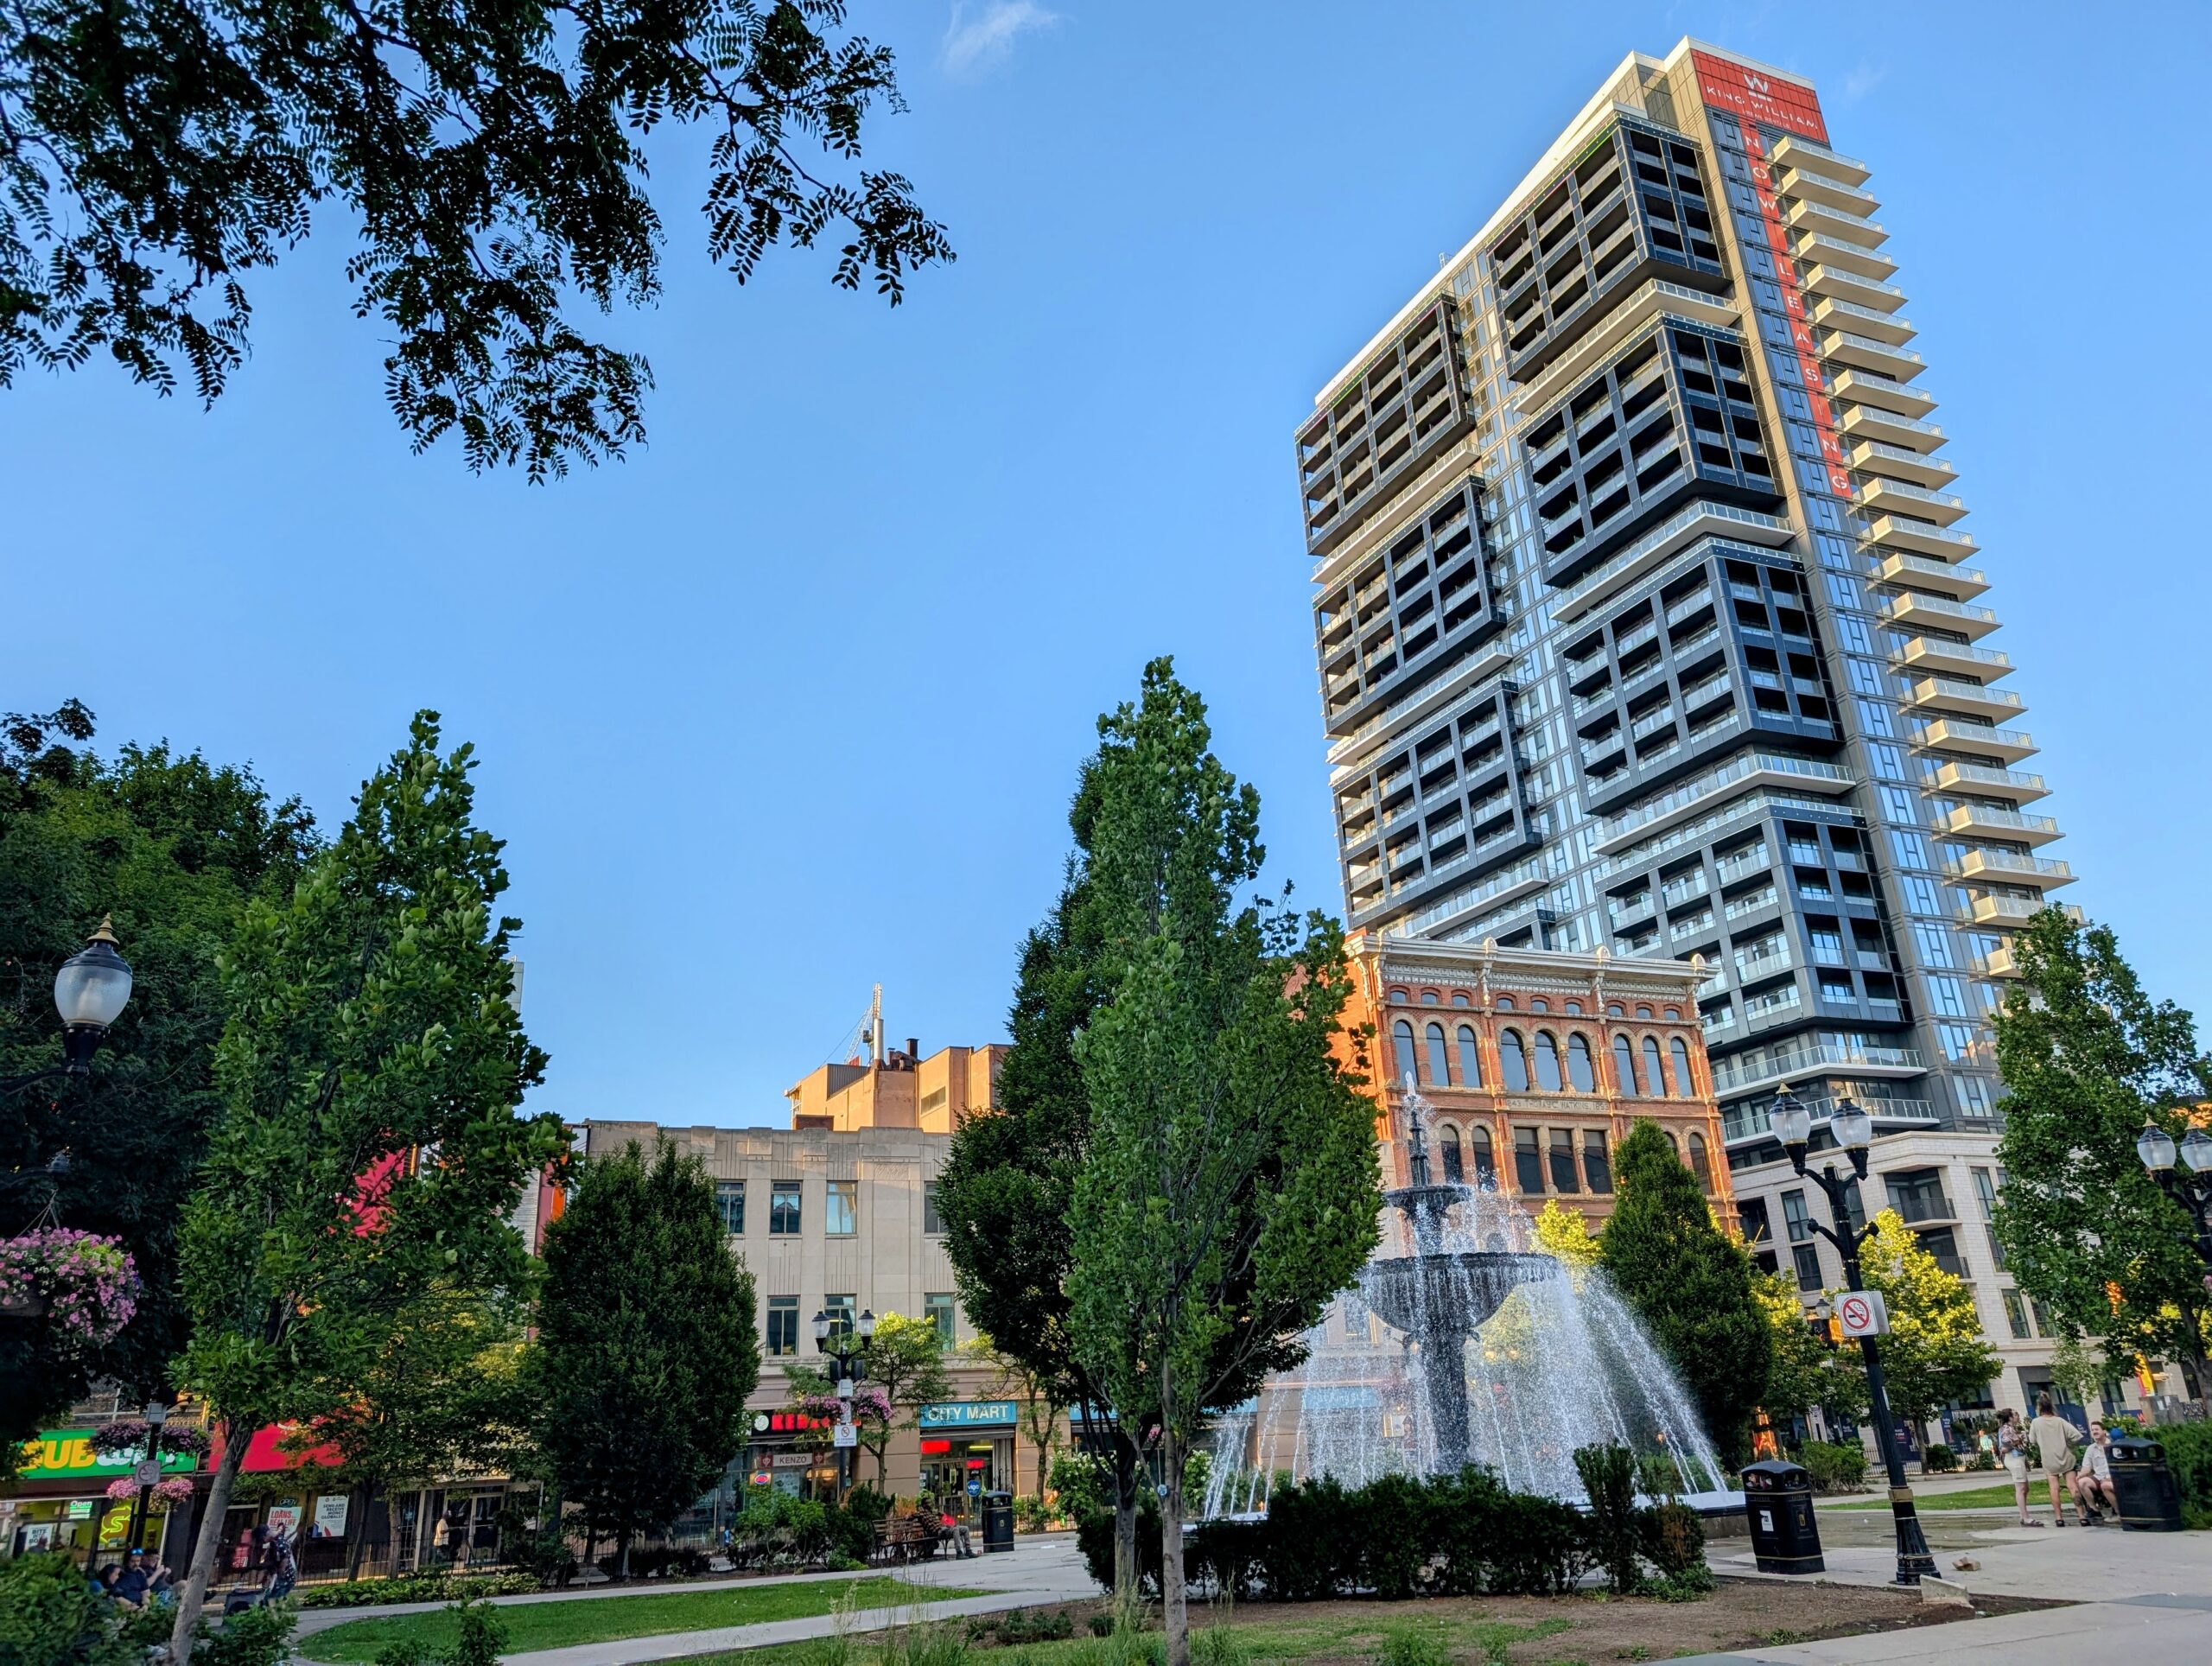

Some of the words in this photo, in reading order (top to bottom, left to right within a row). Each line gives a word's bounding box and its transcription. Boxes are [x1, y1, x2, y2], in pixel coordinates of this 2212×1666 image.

[1707, 86, 1745, 104] KING
[1745, 136, 1777, 210] NOW
[1778, 263, 1848, 490] LEASING
[928, 1407, 962, 1421] CITY
[966, 1405, 1008, 1420] MART
[779, 1456, 807, 1465] KENZO
[270, 1510, 292, 1519] LOANS
